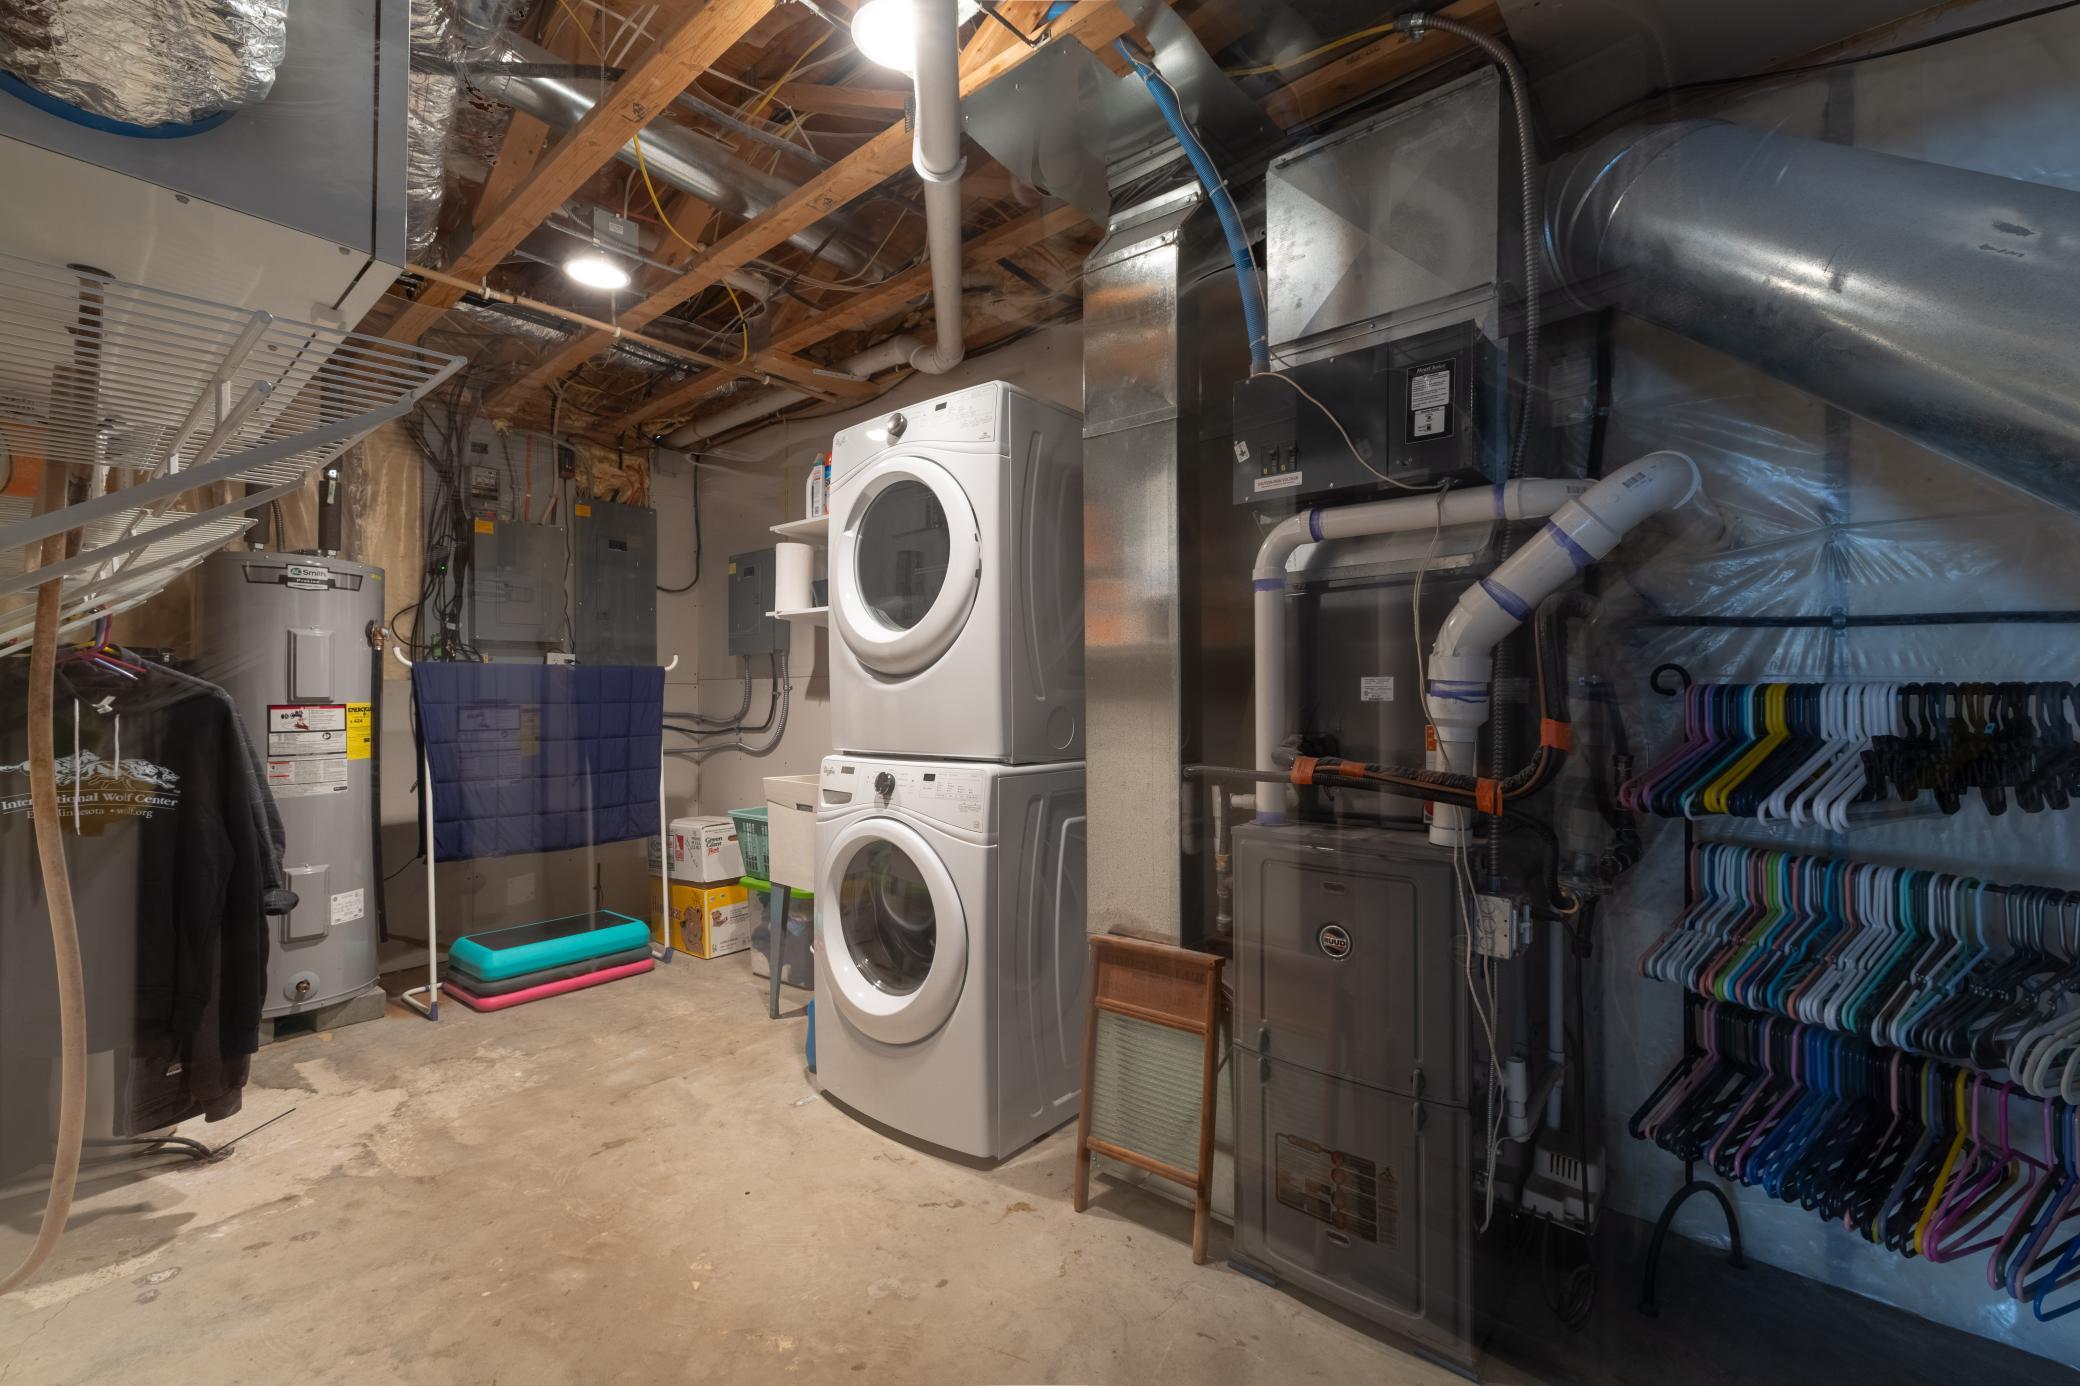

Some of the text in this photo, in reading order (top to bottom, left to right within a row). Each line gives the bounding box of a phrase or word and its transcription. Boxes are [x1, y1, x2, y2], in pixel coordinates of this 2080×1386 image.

[302, 569, 327, 578] Smith
[1, 792, 179, 810] Intertional Wolf Center
[56, 807, 153, 819] inesota wolf.org
[1322, 936, 1346, 947] RUUD
